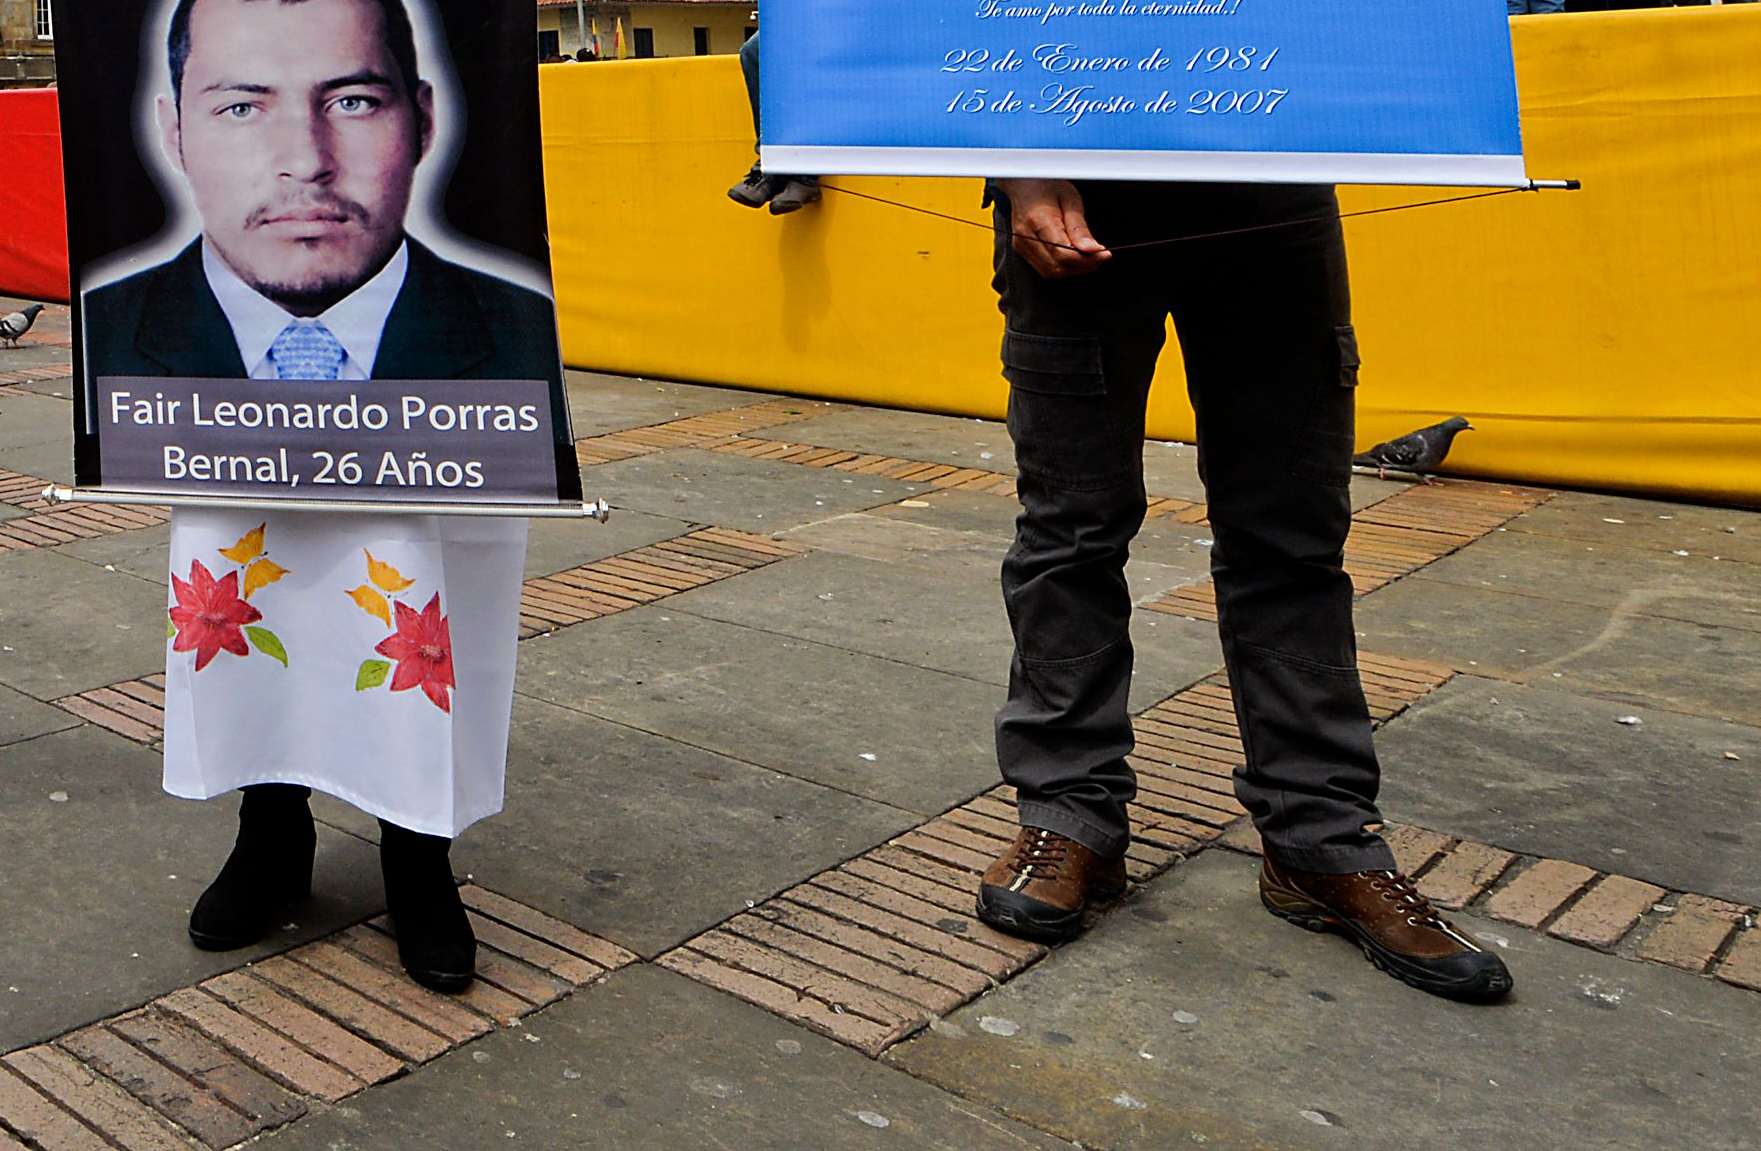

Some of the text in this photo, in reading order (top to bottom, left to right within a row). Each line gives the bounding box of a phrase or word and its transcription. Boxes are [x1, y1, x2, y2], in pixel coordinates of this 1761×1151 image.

[1005, 3, 1041, 17] amo
[1039, 2, 1075, 25] por
[940, 43, 1280, 74] 22 de Enero de 1981
[945, 82, 1290, 127] 15 de Agosto de 2007
[110, 391, 539, 434] Fair Leonardo Porras
[164, 446, 485, 489] Bernal, 26 Años
